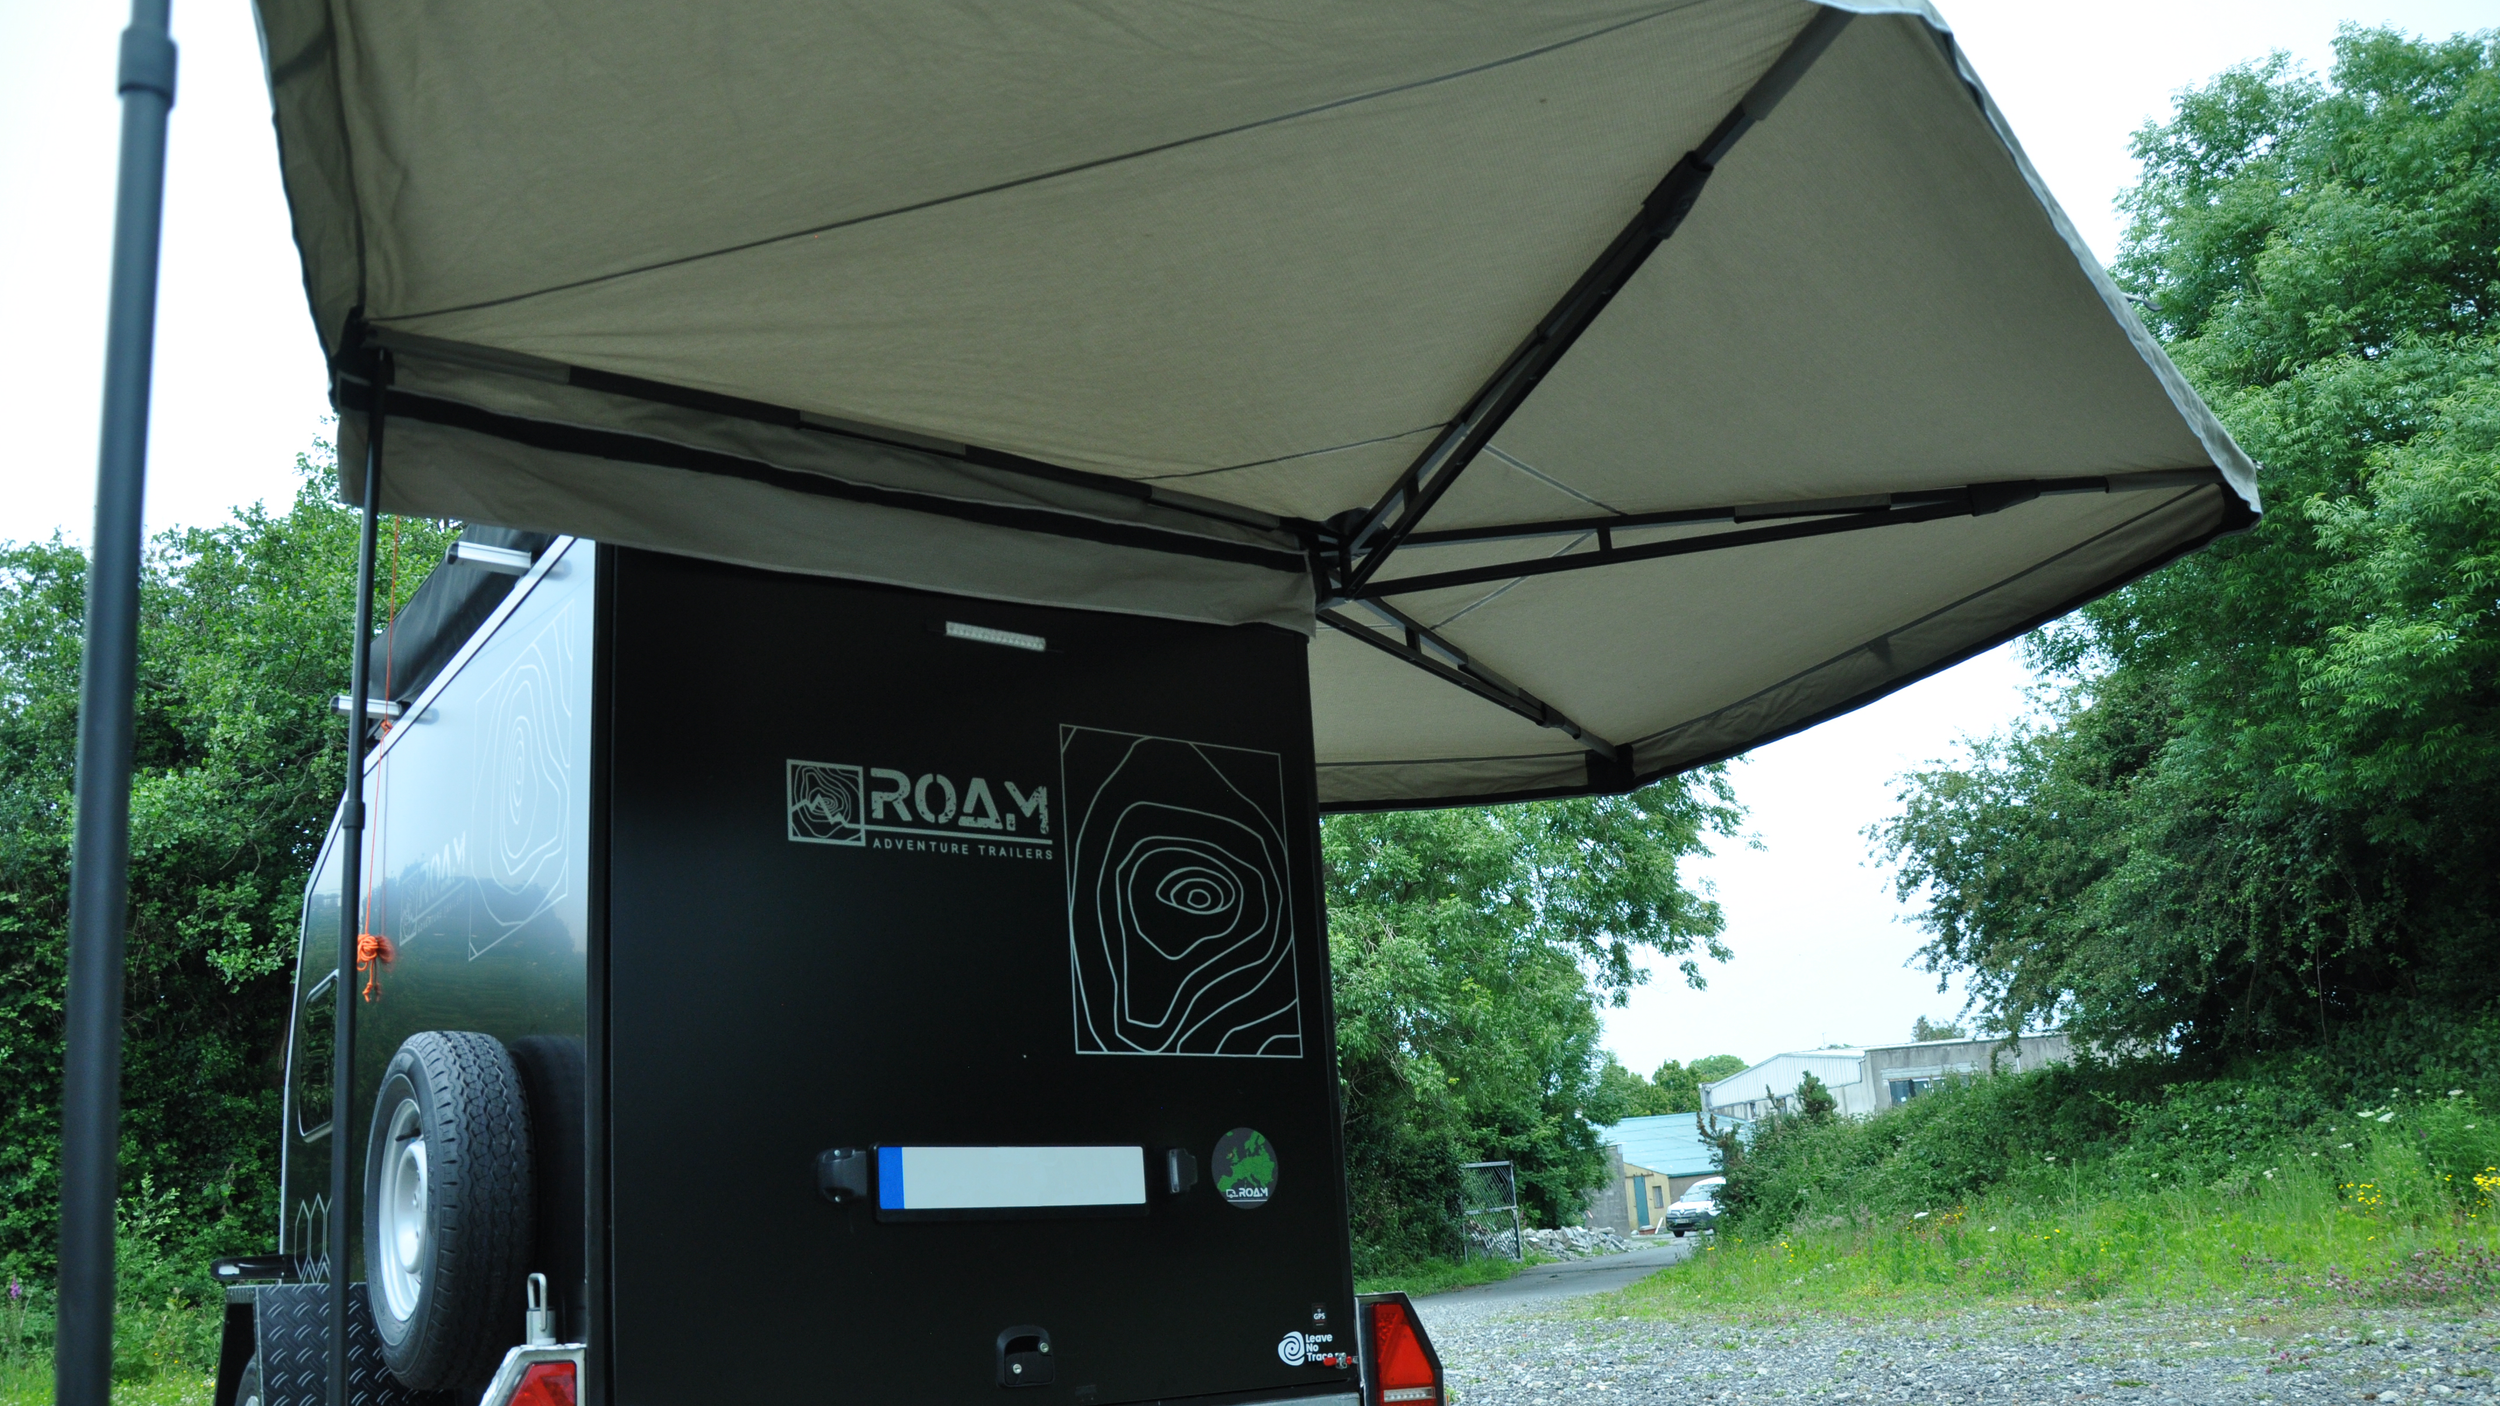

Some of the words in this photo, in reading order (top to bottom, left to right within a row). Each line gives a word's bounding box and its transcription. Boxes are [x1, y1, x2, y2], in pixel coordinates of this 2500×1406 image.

[870, 767, 1050, 834] ROAM
[872, 837, 969, 855] ADVENTURE
[978, 845, 1053, 860] TRAILERS
[1238, 1187, 1269, 1198] ROAM
[1313, 1312, 1326, 1320] GPS
[1305, 1333, 1333, 1343] Leave
[1305, 1343, 1319, 1352] No
